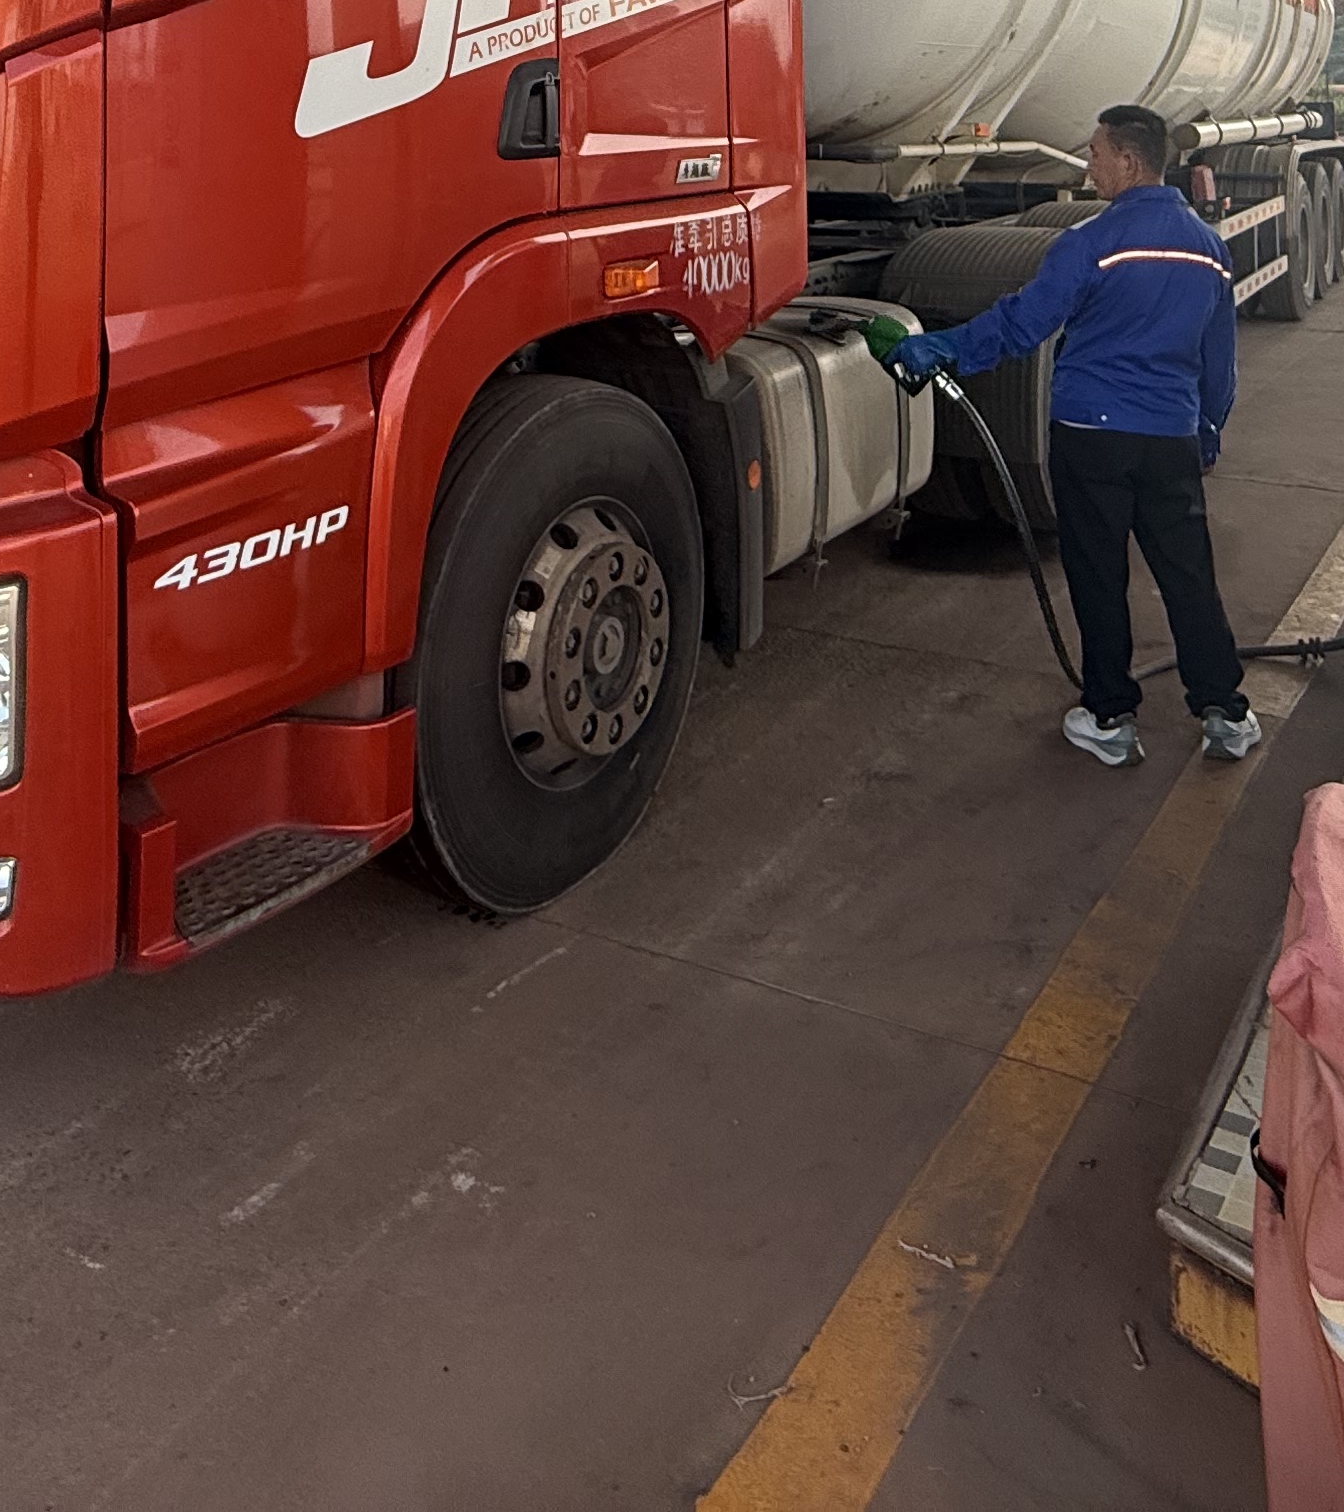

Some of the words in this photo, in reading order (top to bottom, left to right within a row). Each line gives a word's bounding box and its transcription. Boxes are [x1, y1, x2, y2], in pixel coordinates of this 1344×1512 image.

[468, 41, 484, 63] A
[487, 11, 577, 57] PRODUCT
[579, 4, 601, 25] OF
[153, 505, 349, 590] 430HP
